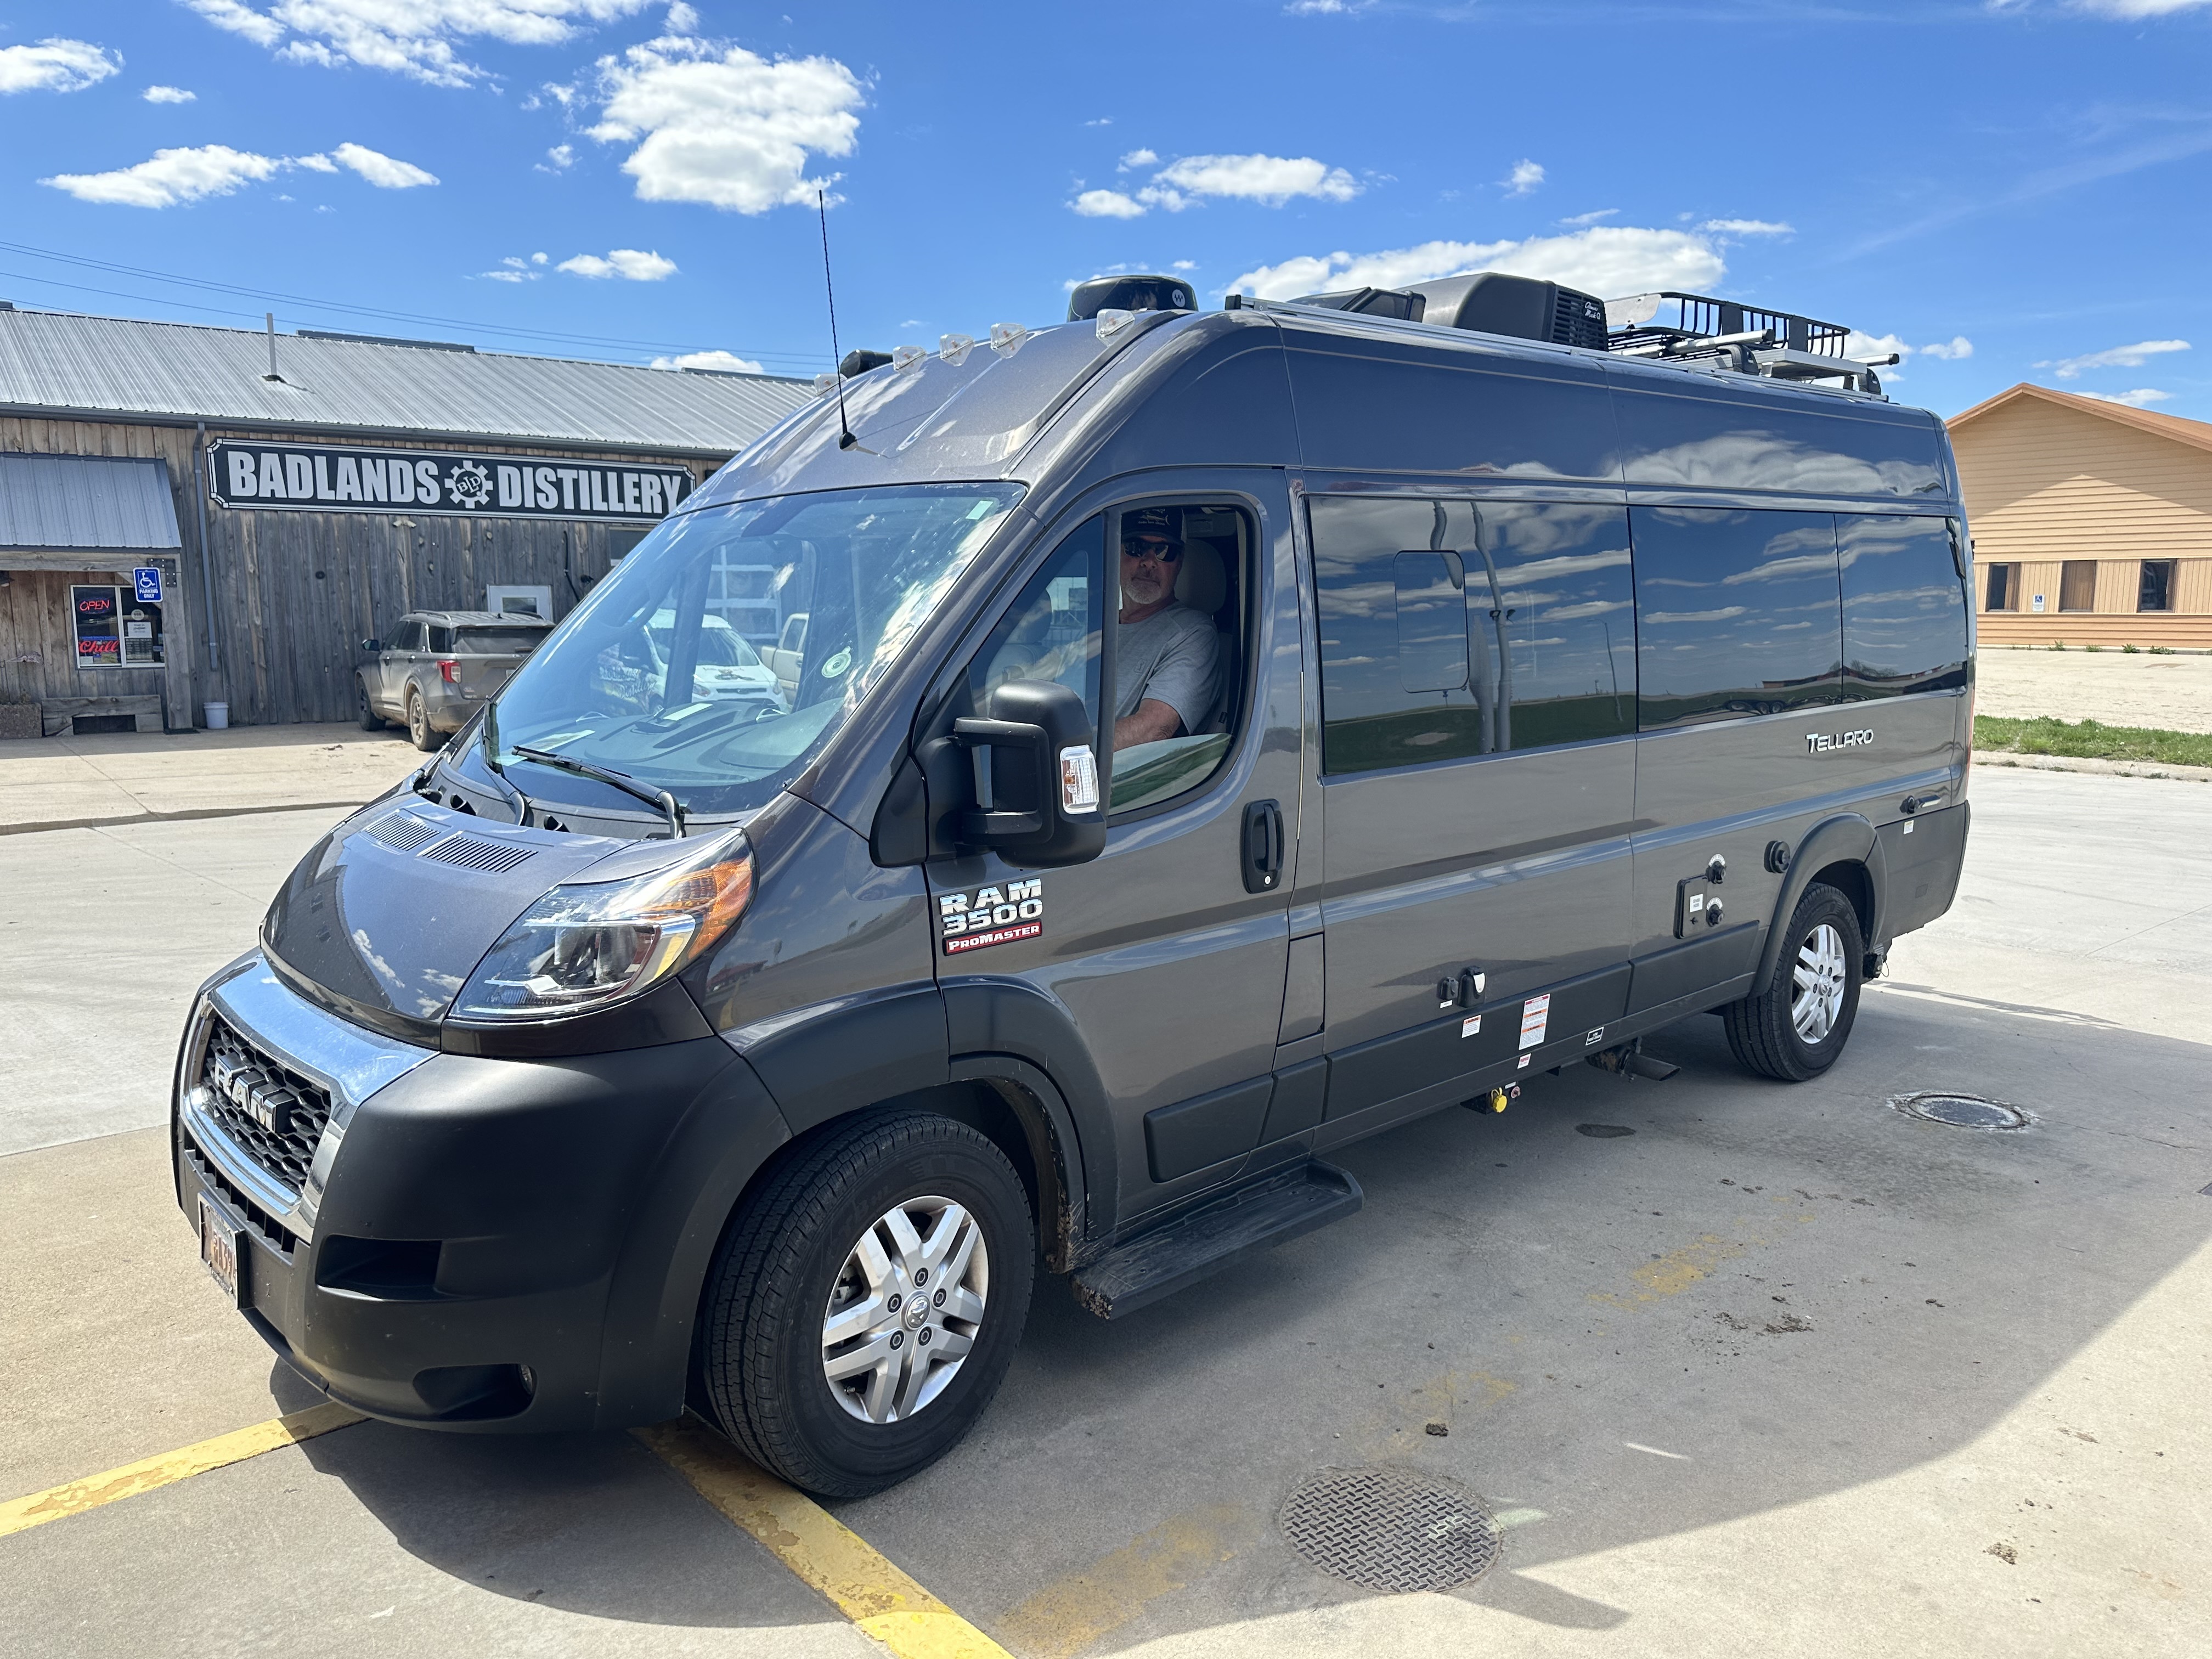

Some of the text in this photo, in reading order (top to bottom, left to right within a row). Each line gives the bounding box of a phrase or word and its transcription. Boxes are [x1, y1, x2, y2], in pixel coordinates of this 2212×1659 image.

[228, 451, 682, 515] BADLANDS DISTILLERY
[456, 476, 481, 493] BLD
[80, 600, 110, 611] OPEN
[79, 640, 119, 653] Chill
[1805, 729, 1874, 753] TELLARO
[940, 878, 1042, 915] RAM
[942, 899, 1043, 935] 3500
[215, 1057, 277, 1132] RAM
